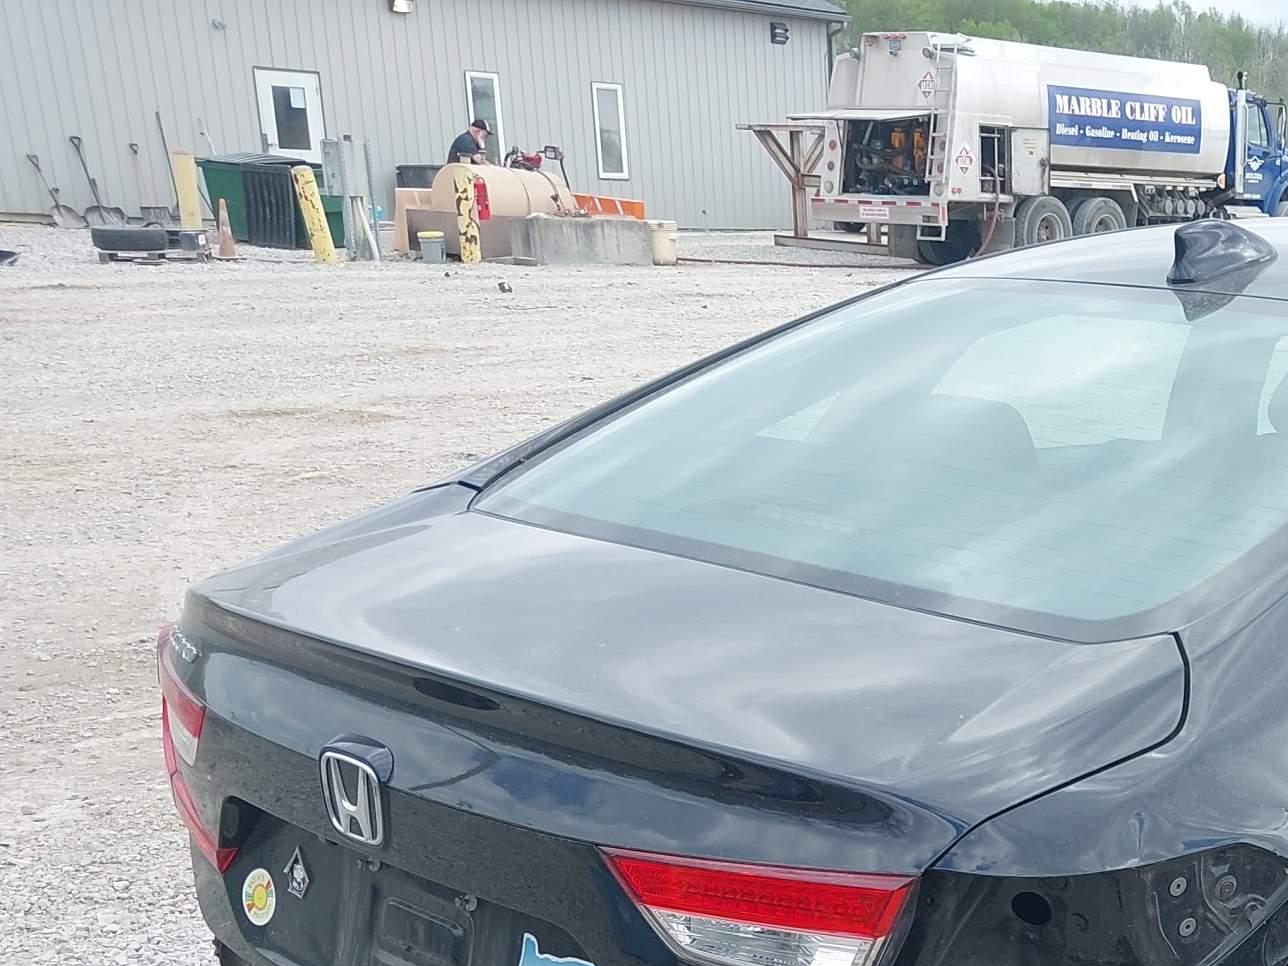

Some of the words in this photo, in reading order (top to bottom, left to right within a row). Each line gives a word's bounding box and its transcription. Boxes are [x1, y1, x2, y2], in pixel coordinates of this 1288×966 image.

[1055, 94, 1121, 118] MARBLE
[1125, 101, 1168, 122] CLIFF
[1171, 105, 1196, 125] OIL
[1056, 123, 1079, 136] Diesel
[1085, 126, 1115, 138] Gasoline
[1121, 128, 1147, 143] Heating
[1149, 131, 1159, 142] Oil
[1164, 132, 1196, 145] Kerosene
